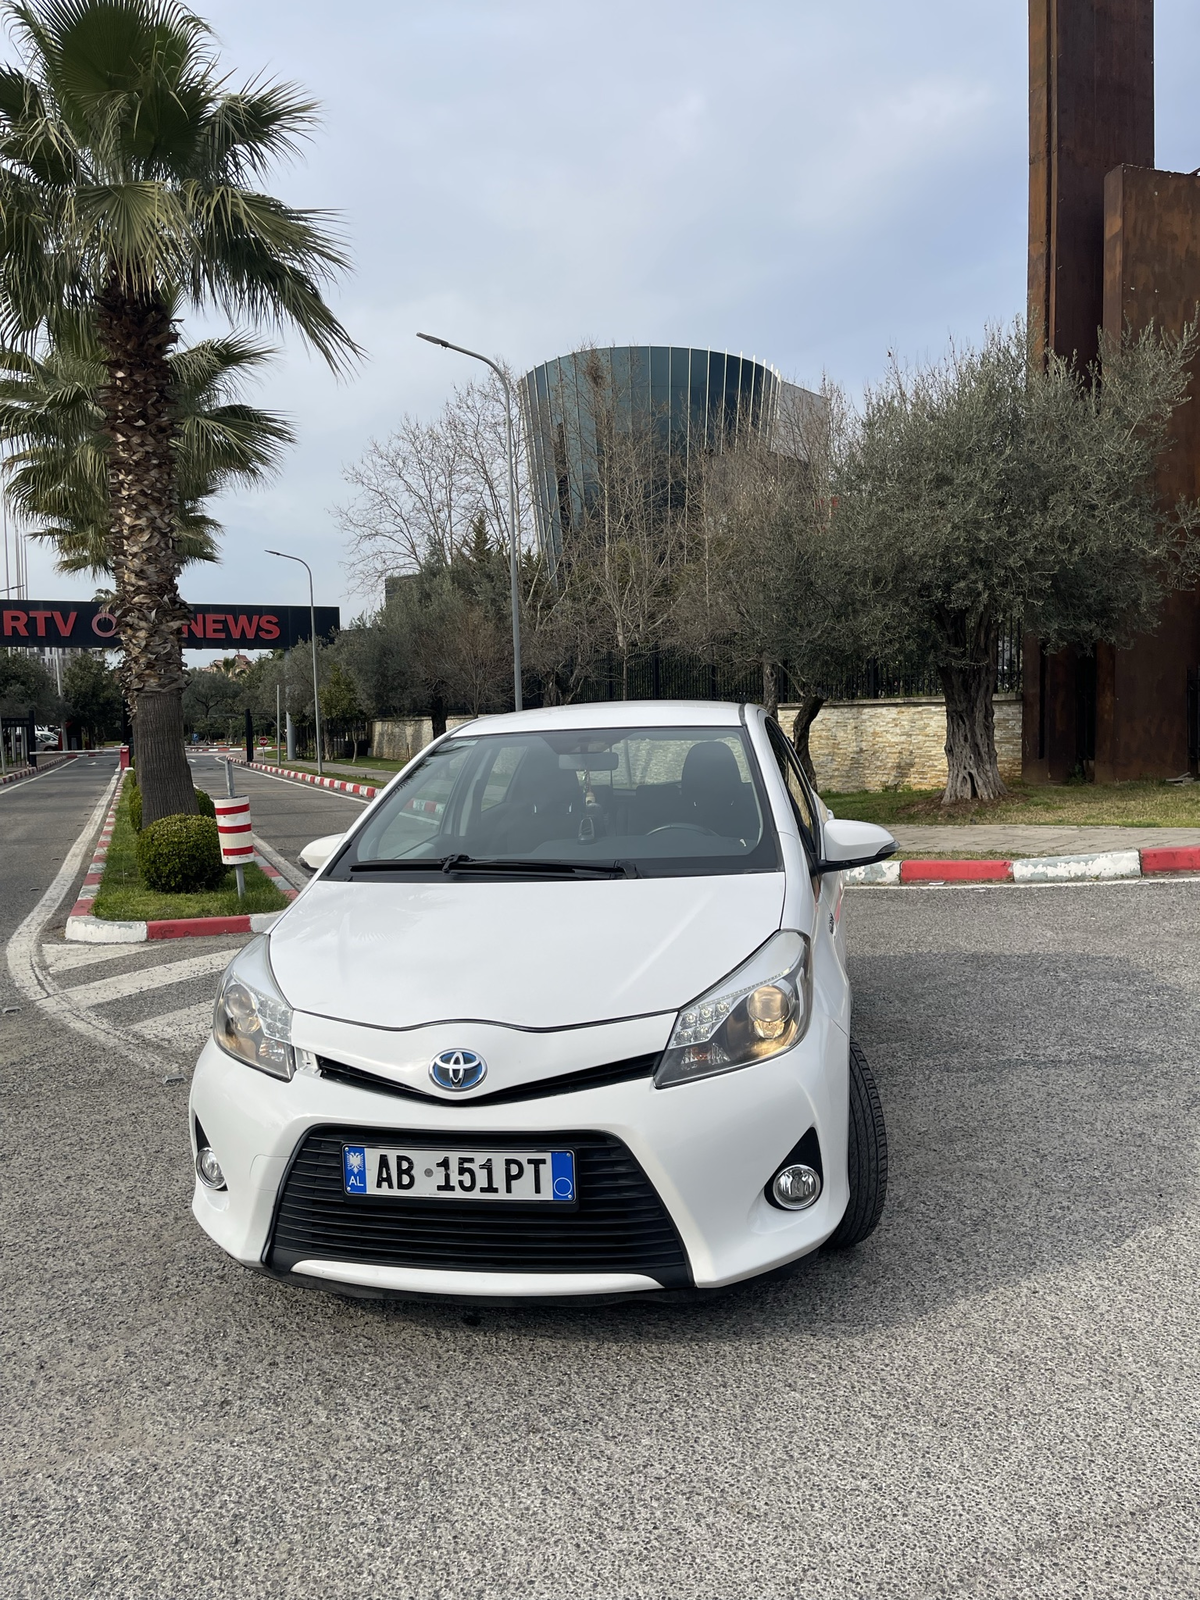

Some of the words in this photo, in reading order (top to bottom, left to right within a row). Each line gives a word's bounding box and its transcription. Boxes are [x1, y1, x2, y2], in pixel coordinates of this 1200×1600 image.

[2, 610, 78, 637] RTV
[181, 613, 281, 640] NEWS
[348, 1175, 365, 1187] AL
[375, 1153, 416, 1190] AB
